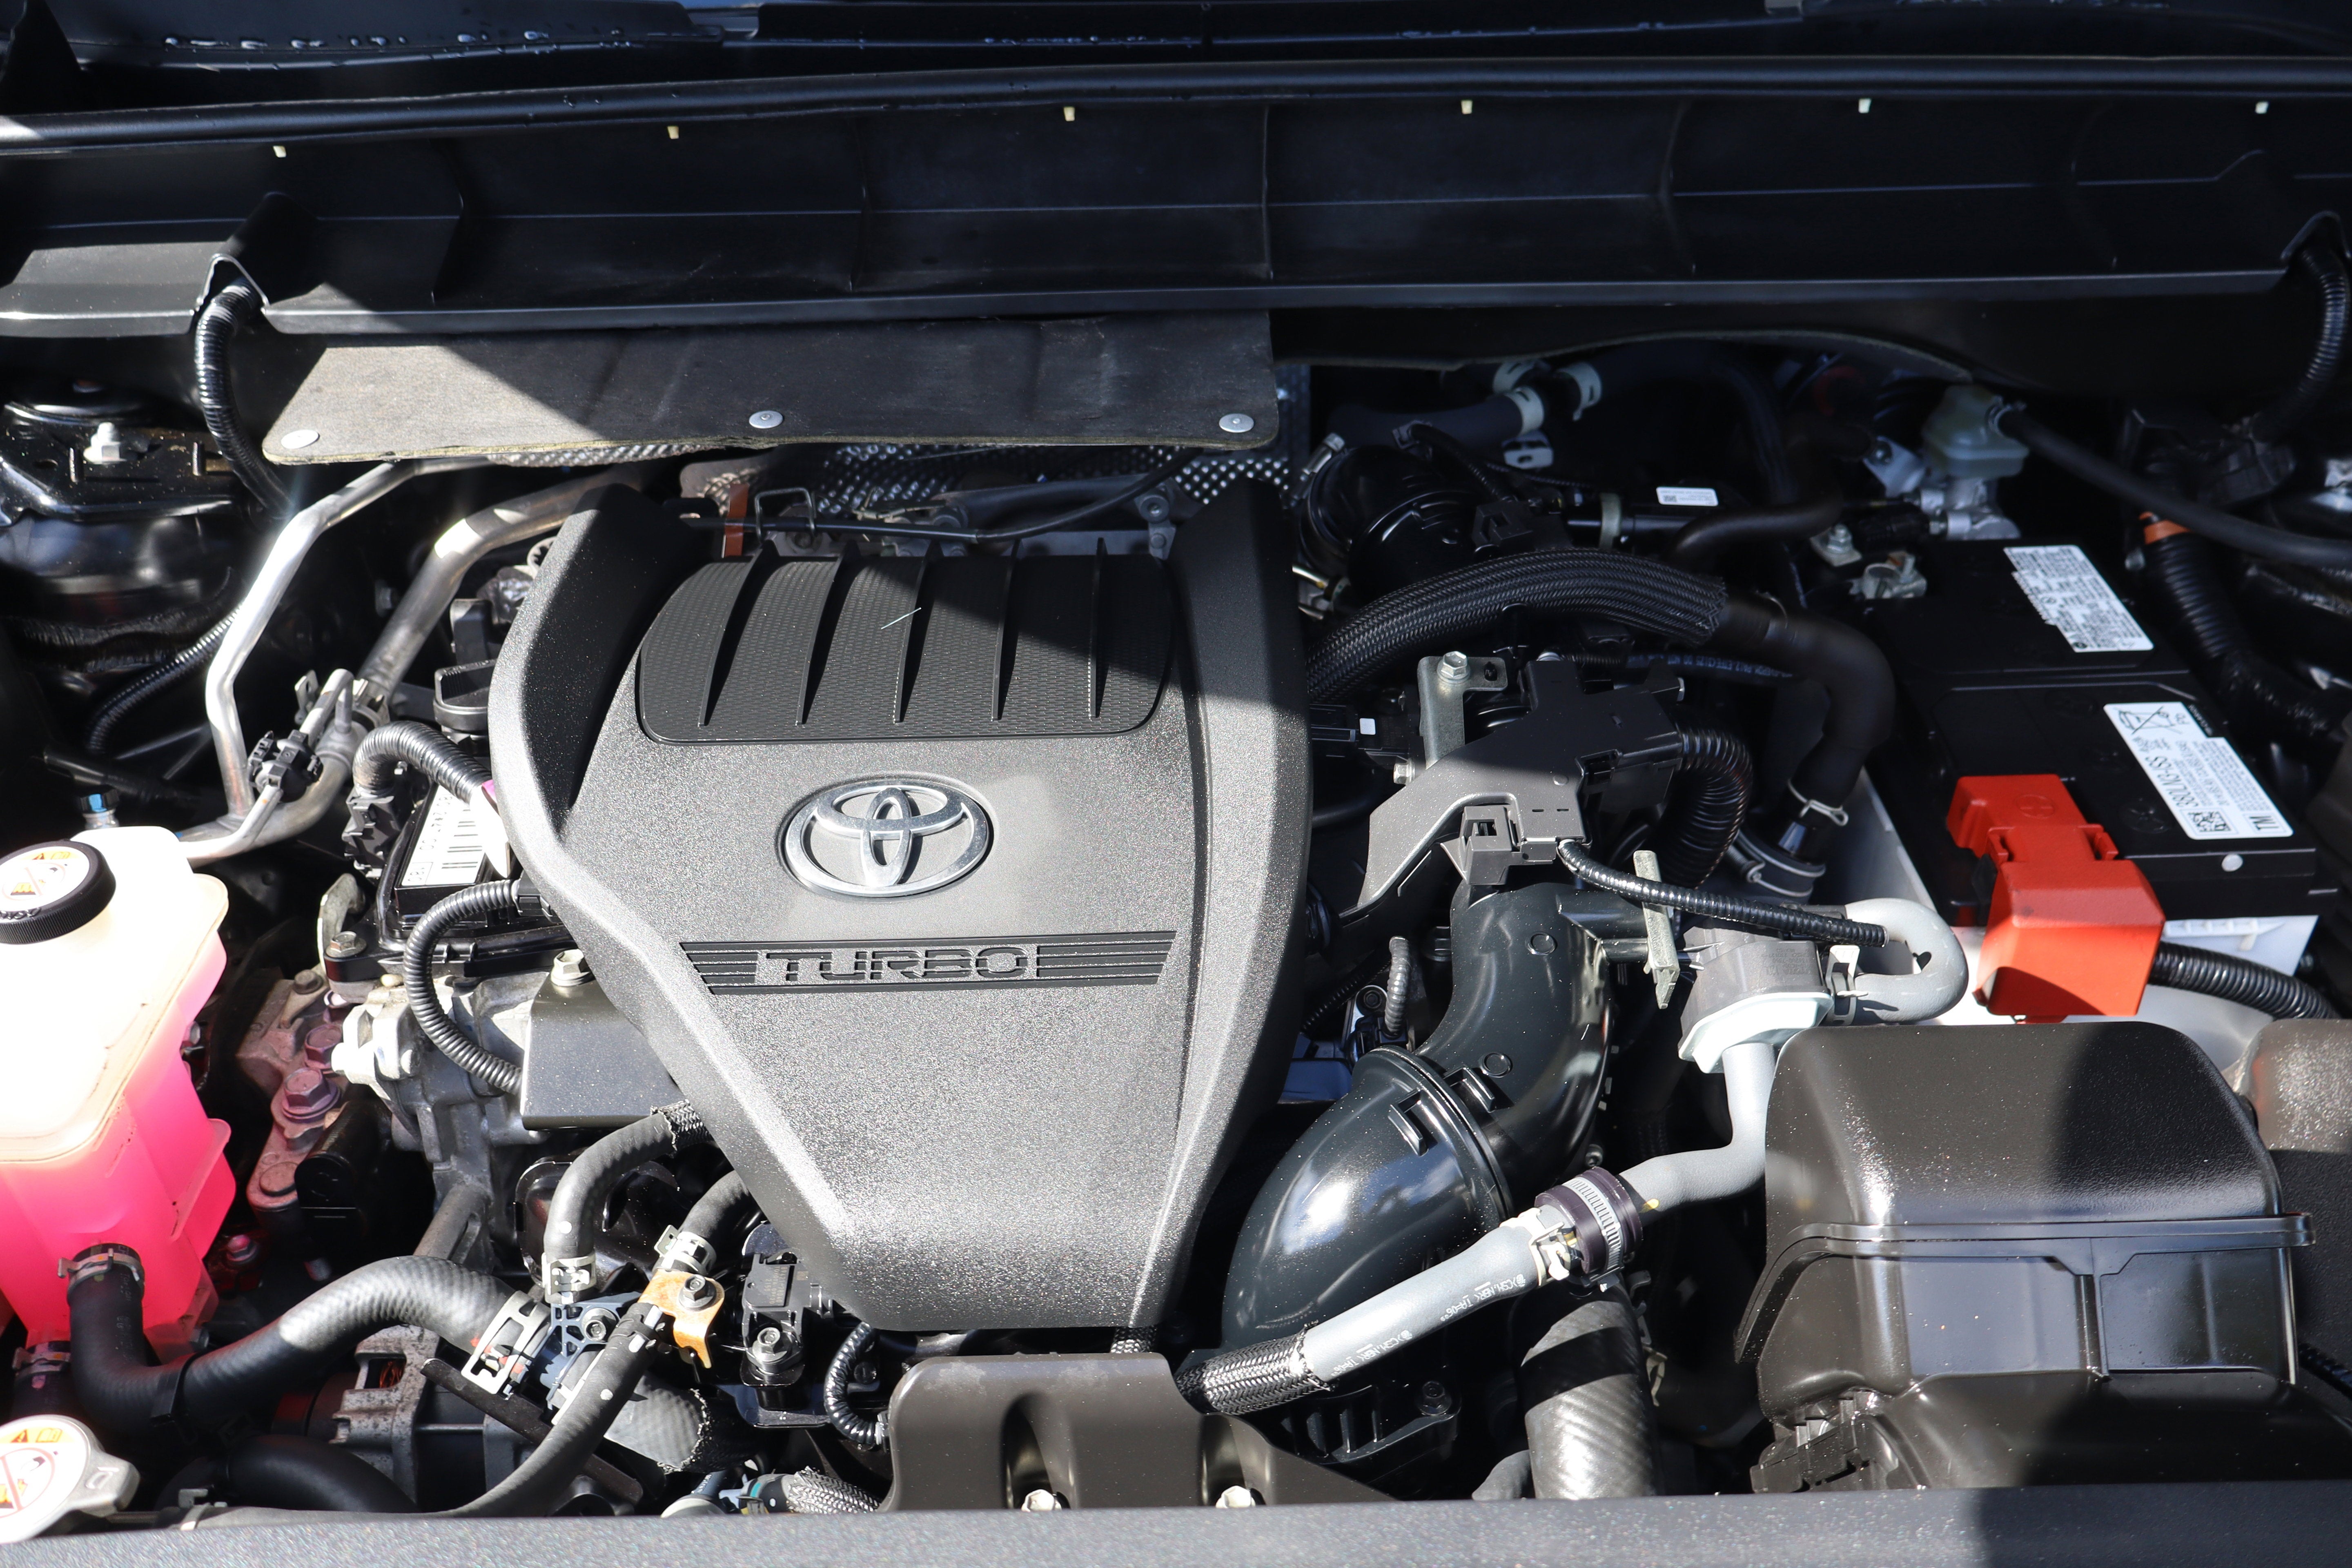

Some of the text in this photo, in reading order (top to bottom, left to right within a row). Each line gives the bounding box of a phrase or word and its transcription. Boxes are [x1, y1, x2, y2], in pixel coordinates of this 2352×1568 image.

[2249, 815, 2280, 831] TM
[766, 947, 1028, 980] TURBO
[772, 1267, 780, 1285] TOYOTA
[764, 1278, 772, 1292] 2150
